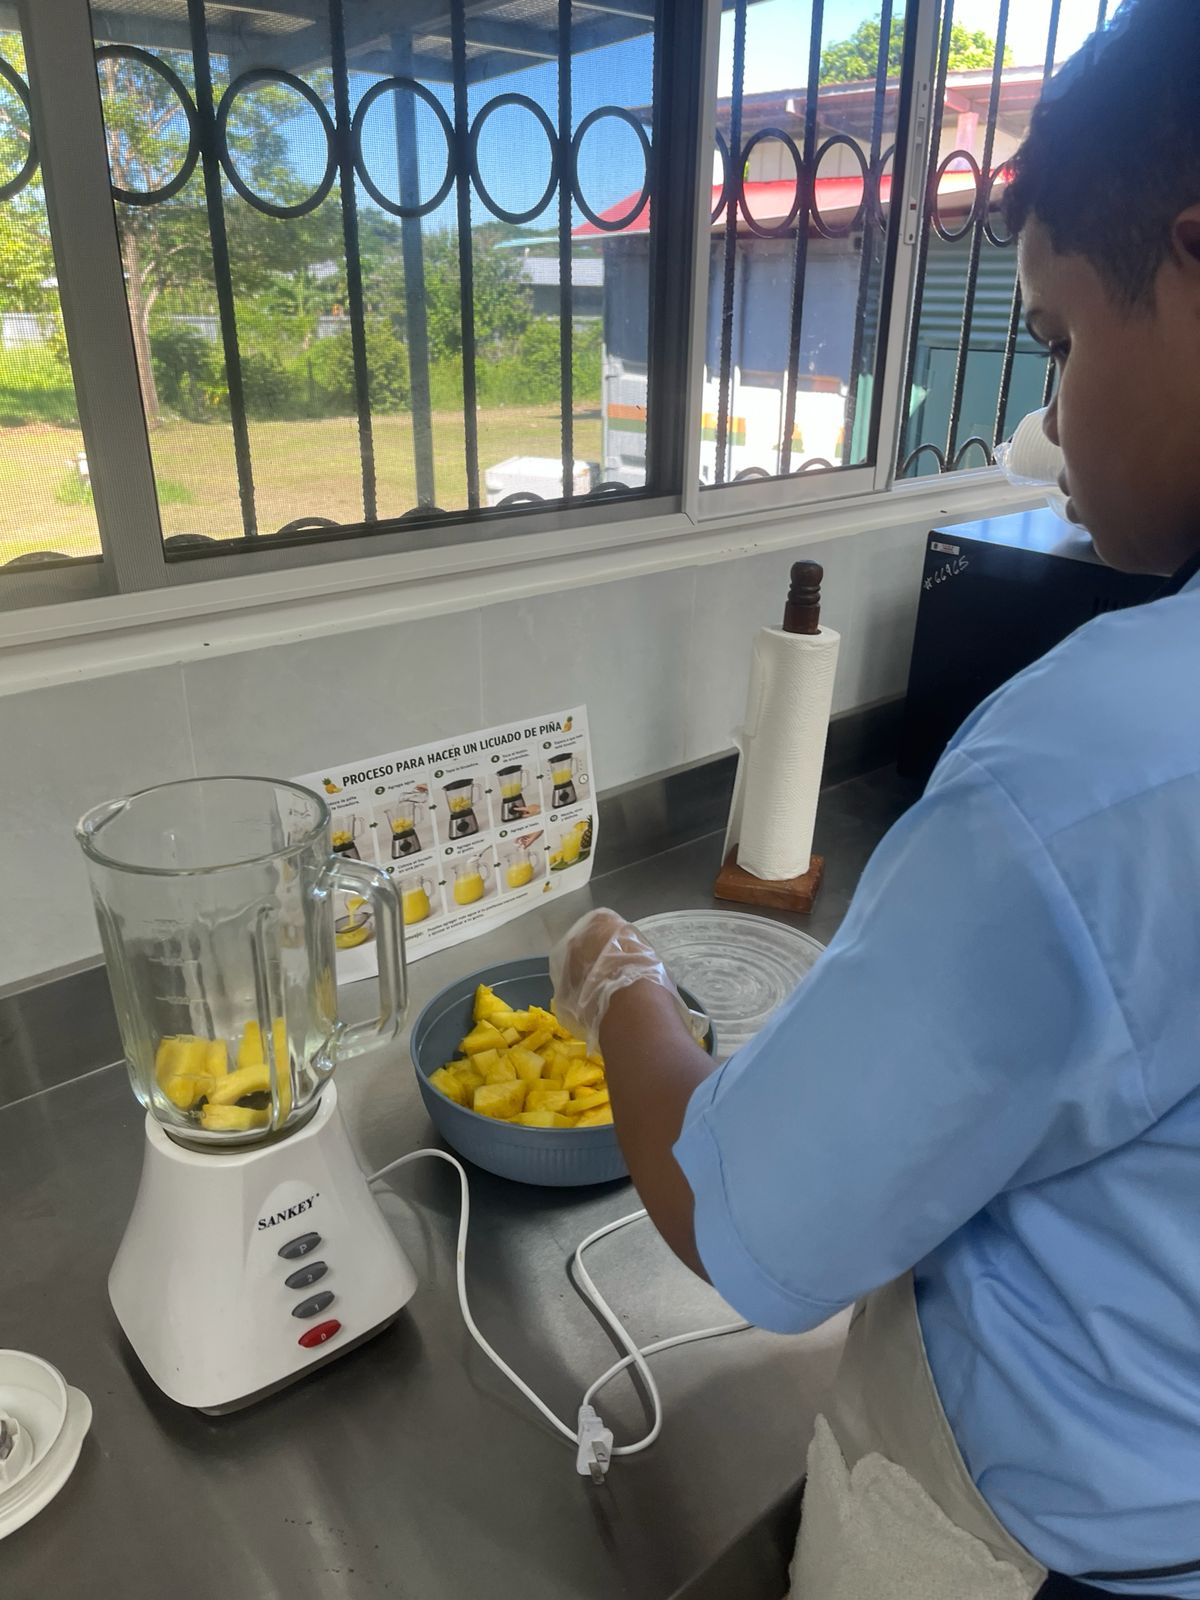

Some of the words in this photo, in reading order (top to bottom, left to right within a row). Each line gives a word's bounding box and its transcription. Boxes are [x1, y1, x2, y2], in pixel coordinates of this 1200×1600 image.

[342, 765, 394, 787] PROCESO
[396, 757, 425, 773] PARA
[427, 747, 461, 764] HACER
[463, 742, 478, 755] UN
[480, 731, 521, 751] LICUADO
[524, 727, 538, 739] DE
[540, 721, 562, 735] PIÑA
[257, 1196, 314, 1231] SANKEY
[299, 1244, 307, 1255] P
[308, 1274, 313, 1282] 2
[315, 1303, 319, 1311] 1
